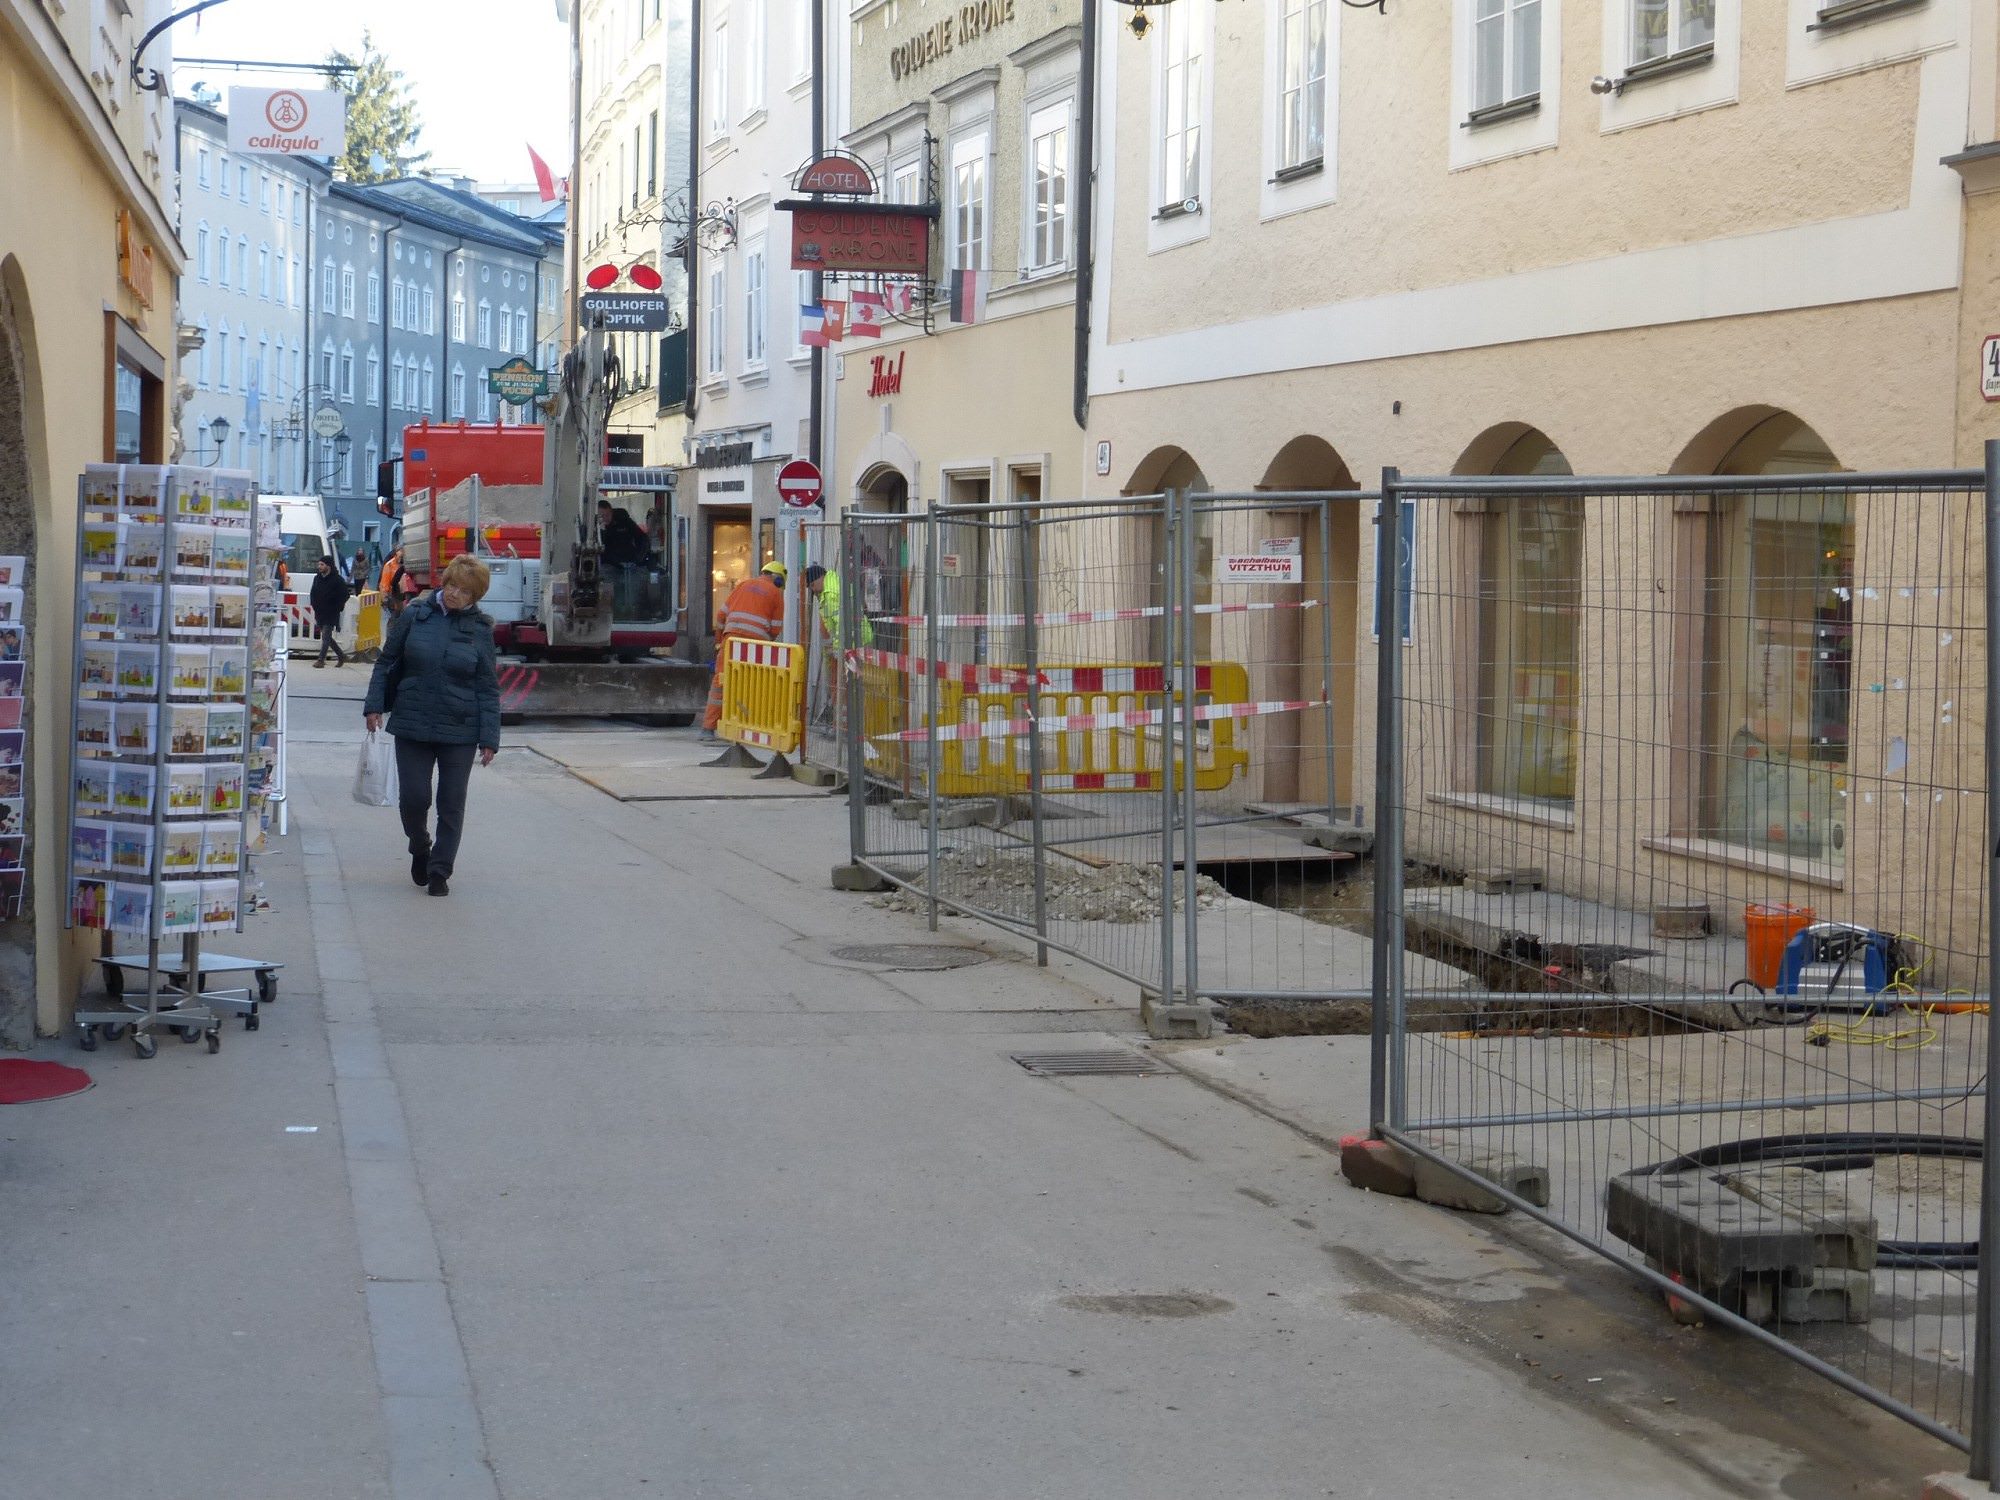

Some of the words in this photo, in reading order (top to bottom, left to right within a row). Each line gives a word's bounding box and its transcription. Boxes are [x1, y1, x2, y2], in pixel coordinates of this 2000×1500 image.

[890, 15, 953, 81] GOLDENE
[958, 0, 1015, 46] KRONE
[248, 134, 320, 153] caligula
[806, 172, 864, 189] HOTEL
[799, 212, 913, 237] GOLDENE
[829, 240, 918, 262] KRONE
[585, 299, 665, 311] GOLLHOFER
[605, 314, 645, 324] OPTIK
[492, 373, 543, 383] PENSION
[867, 350, 905, 398] Hotel
